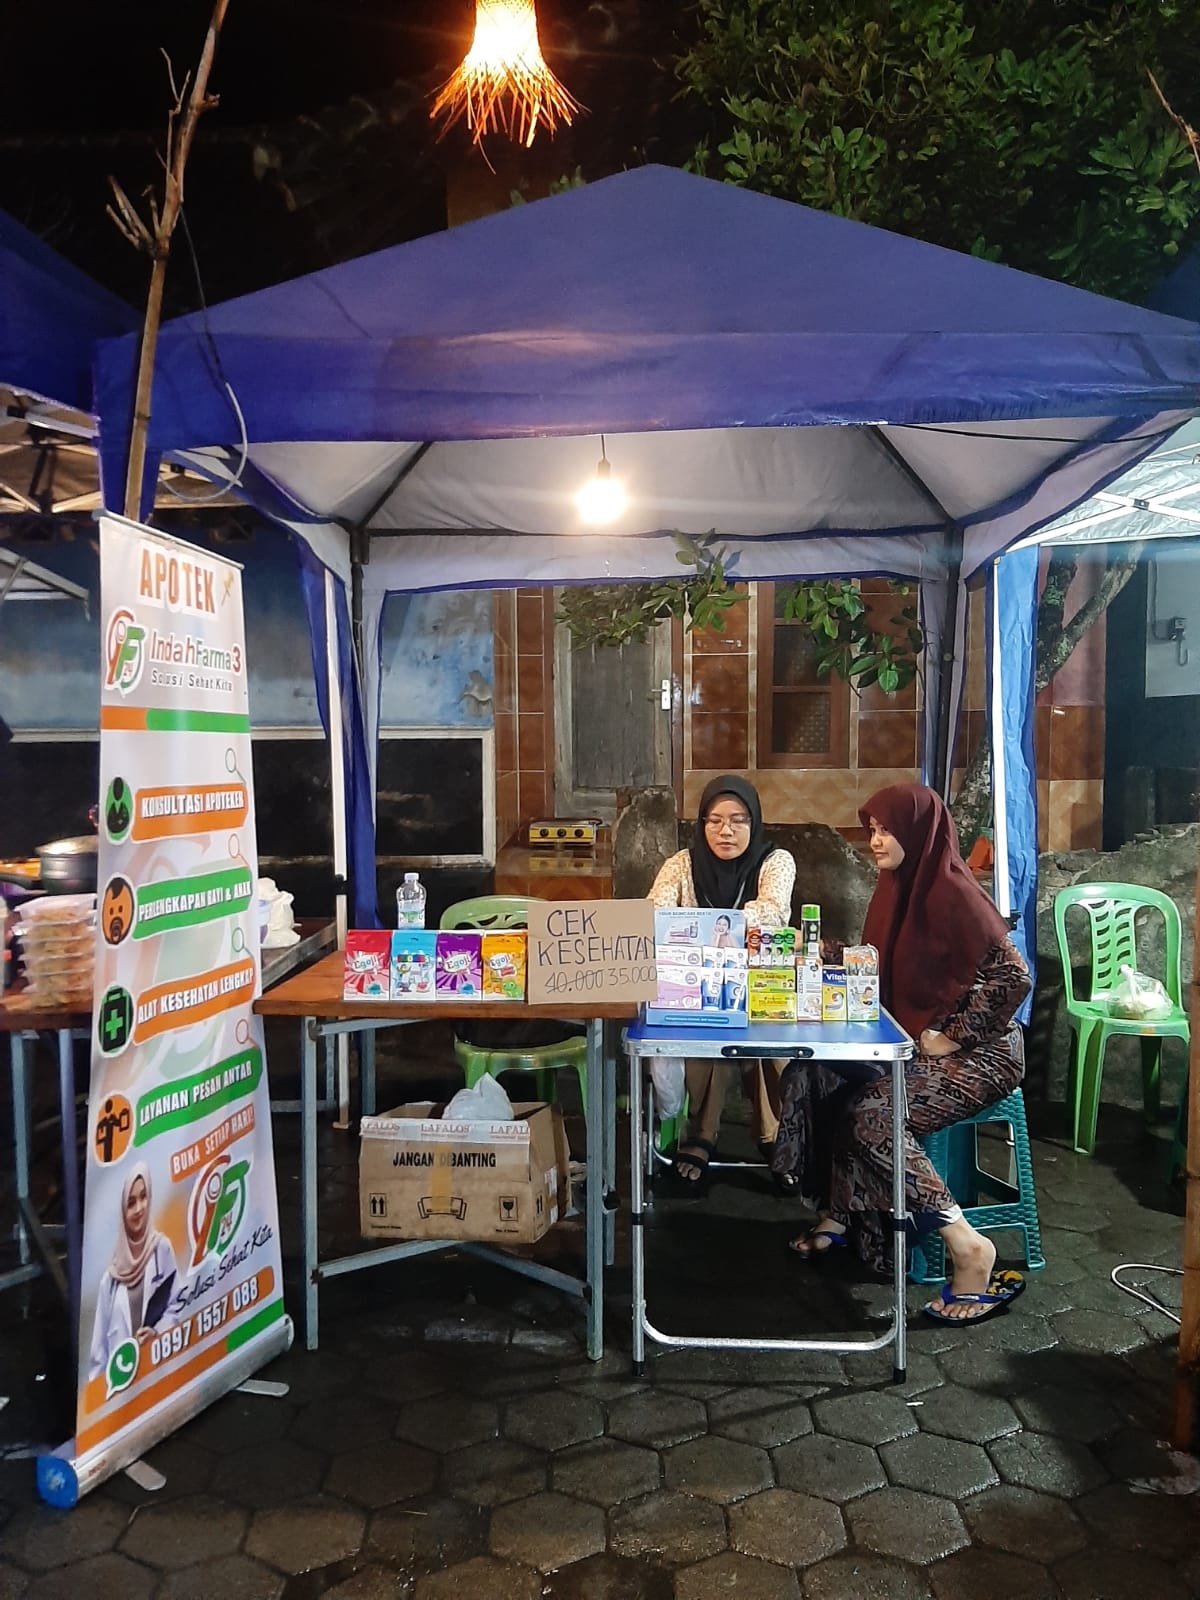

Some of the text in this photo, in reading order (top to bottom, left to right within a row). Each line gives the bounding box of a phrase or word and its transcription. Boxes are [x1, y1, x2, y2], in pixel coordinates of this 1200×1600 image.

[140, 549, 216, 614] APOTEK
[537, 935, 657, 967] KESEHATAN
[546, 908, 598, 937] CEK
[138, 967, 254, 1025] ALAT KESEHATAN LENGKAP
[140, 1060, 253, 1127] LAYANAN PESAN ANTAR
[172, 1144, 200, 1175] BUKA
[204, 1121, 230, 1155] SETIAP
[393, 1151, 434, 1167] JANGAN
[175, 1224, 274, 1313] Solusi Sehat Kita
[151, 1276, 259, 1366] 0897 1557 088
